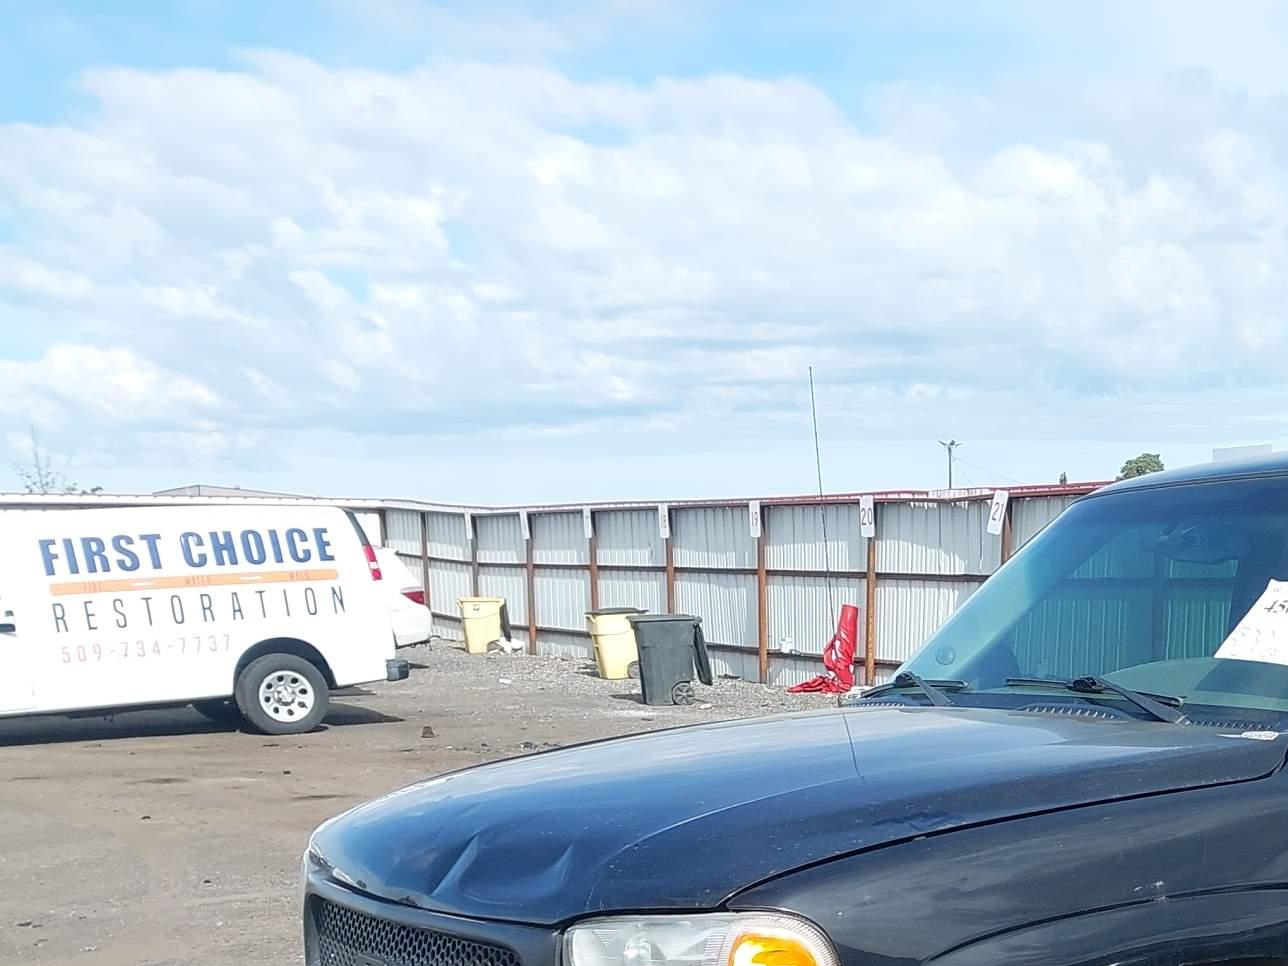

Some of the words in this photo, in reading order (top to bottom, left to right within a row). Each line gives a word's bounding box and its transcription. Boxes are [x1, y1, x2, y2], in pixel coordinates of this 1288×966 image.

[861, 507, 873, 526] 20
[991, 501, 1005, 523] 21
[38, 533, 162, 576] FIRST
[180, 527, 336, 568] CHOICE
[52, 585, 347, 633] RESTORATION
[61, 634, 231, 664] 509-734-7737
